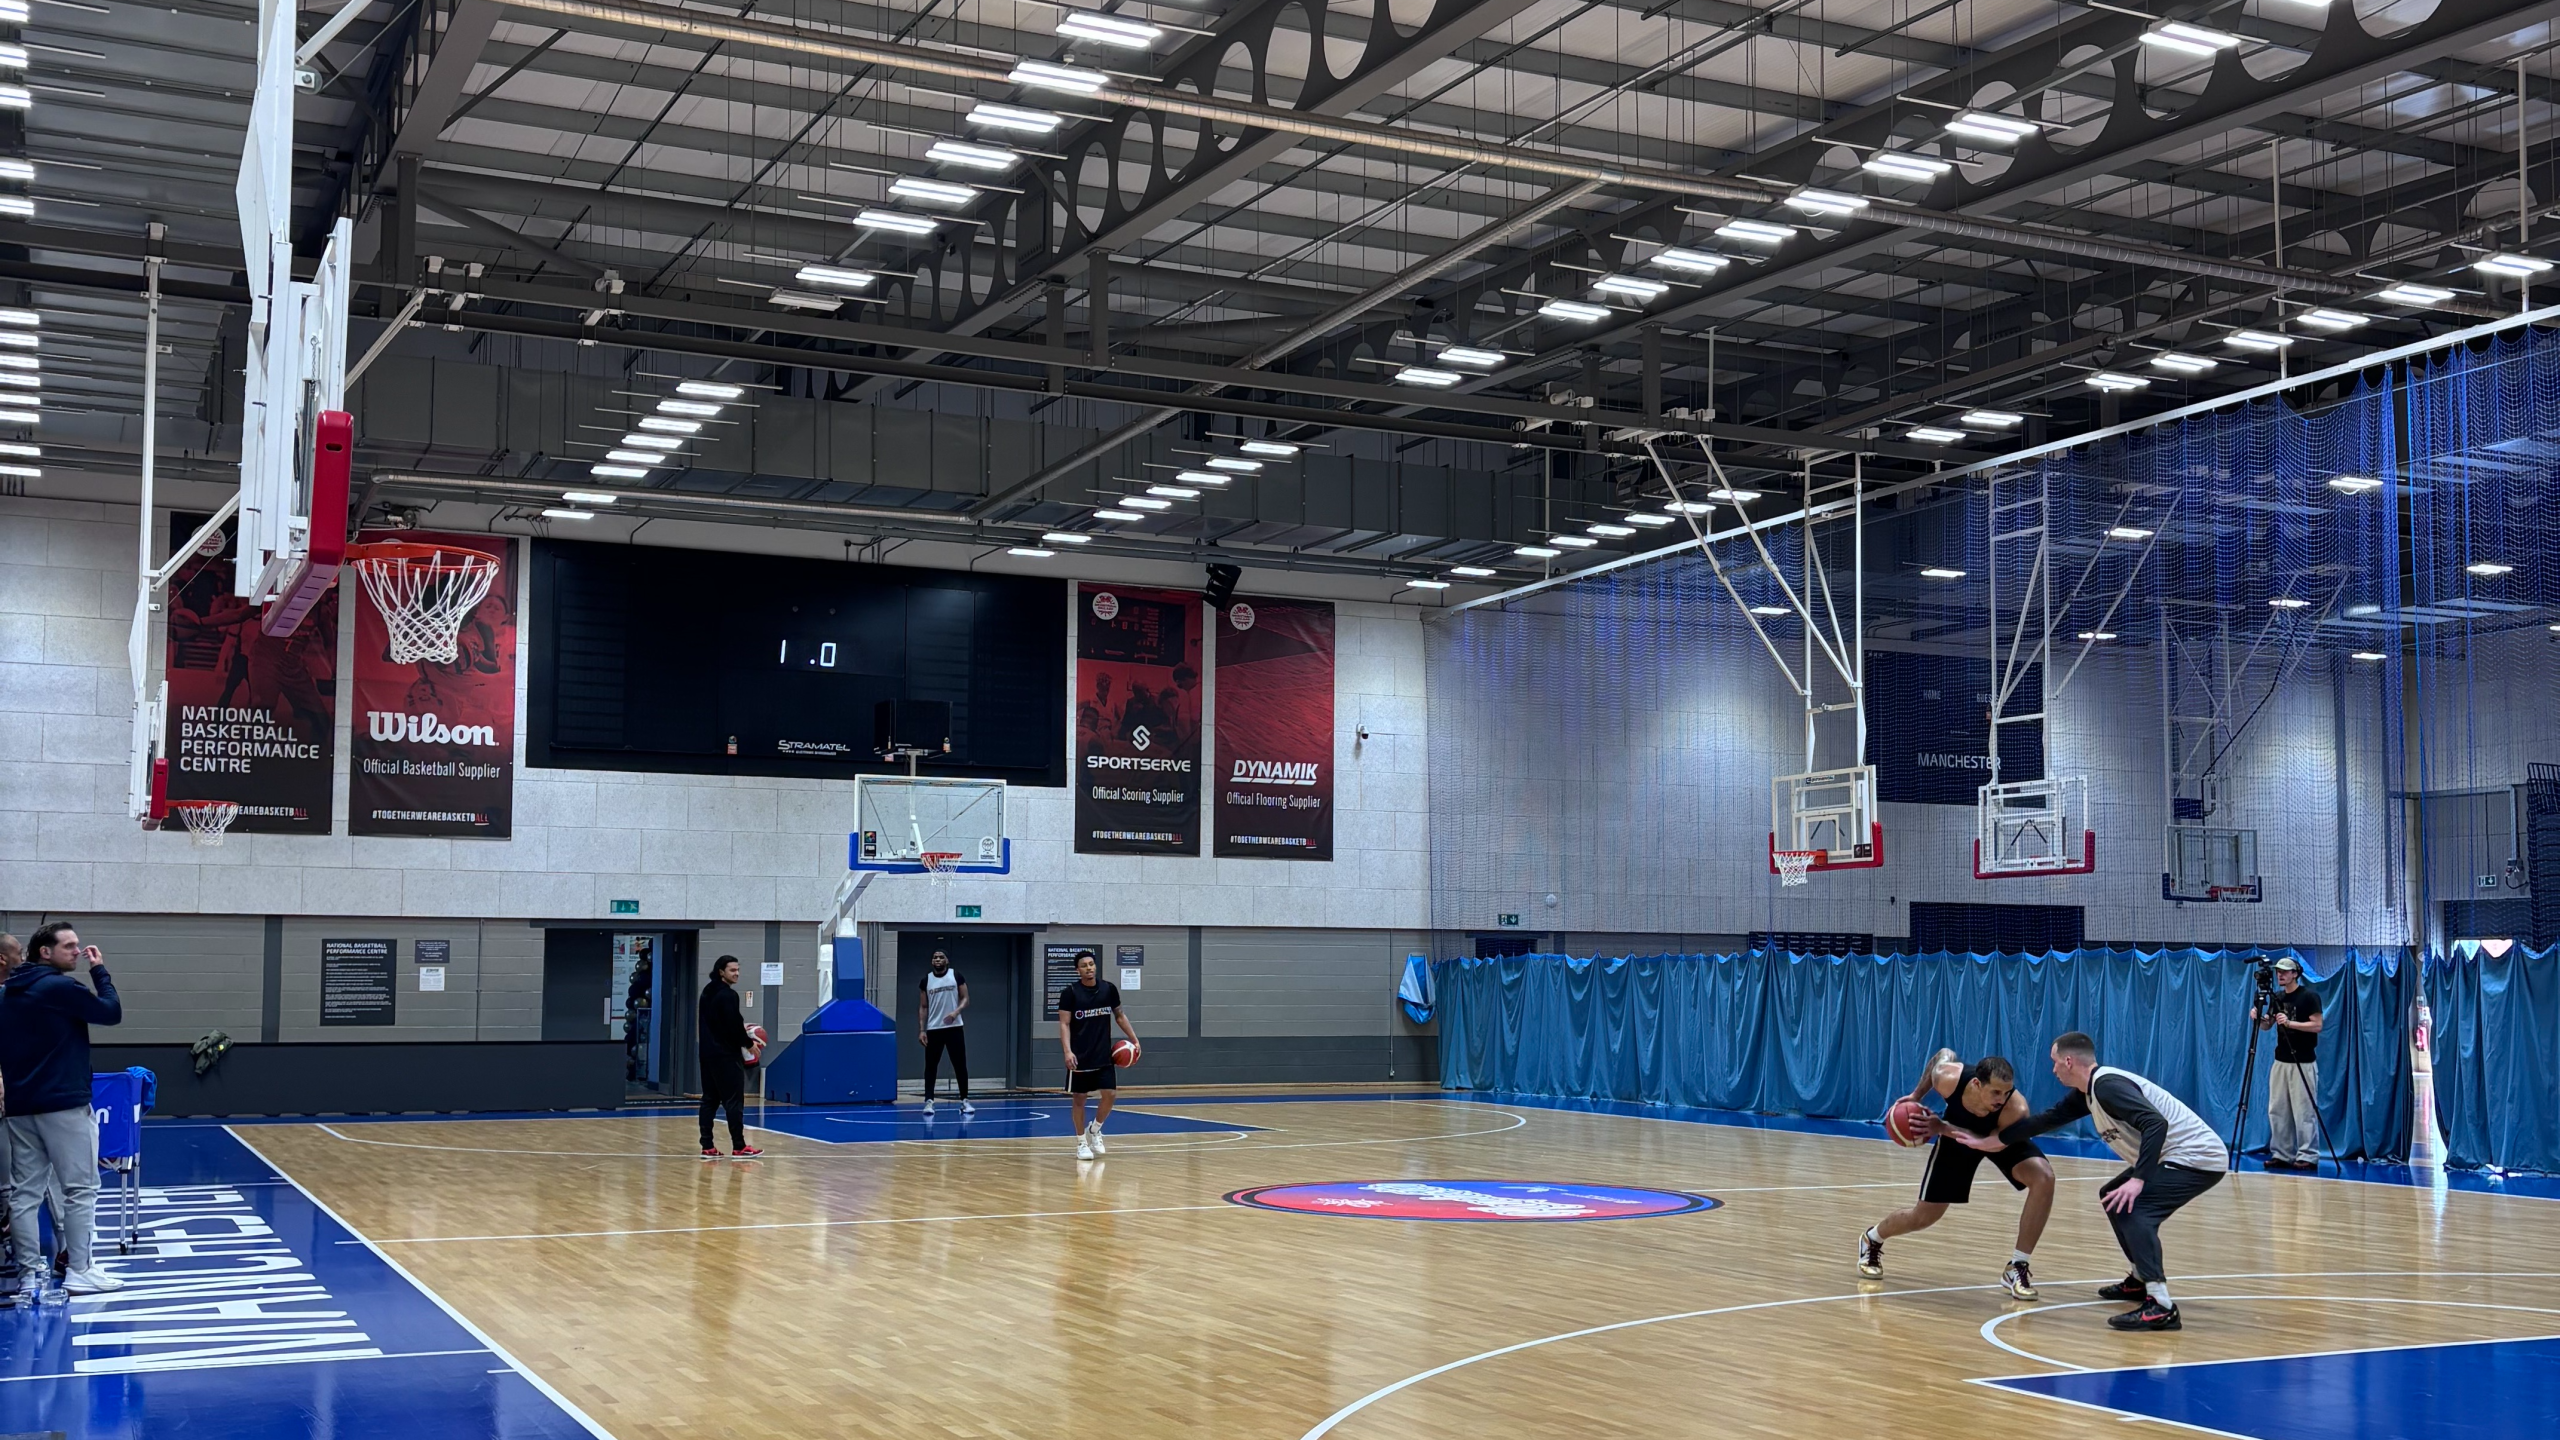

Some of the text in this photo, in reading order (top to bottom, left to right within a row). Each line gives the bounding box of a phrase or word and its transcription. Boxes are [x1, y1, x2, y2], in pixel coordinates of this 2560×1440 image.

[182, 705, 276, 724] NATIONAL
[181, 722, 298, 742] BASKETBALL
[367, 711, 496, 747] Wilson
[181, 739, 320, 759] PERFORMANCE
[777, 739, 851, 752] STRAMATEL
[180, 756, 252, 773] CENTRE
[363, 758, 500, 780] Official Basketball Supplier
[1087, 755, 1191, 772] SPORTSERVE
[1233, 759, 1319, 780] DYNAMIK
[1092, 786, 1185, 805] Official Scoring Supplier
[1226, 791, 1321, 810] Official Flooring Supplier
[372, 810, 490, 823] #TOGETHERWEAREBASKETBALL
[70, 1185, 384, 1372] MANCHESTER
